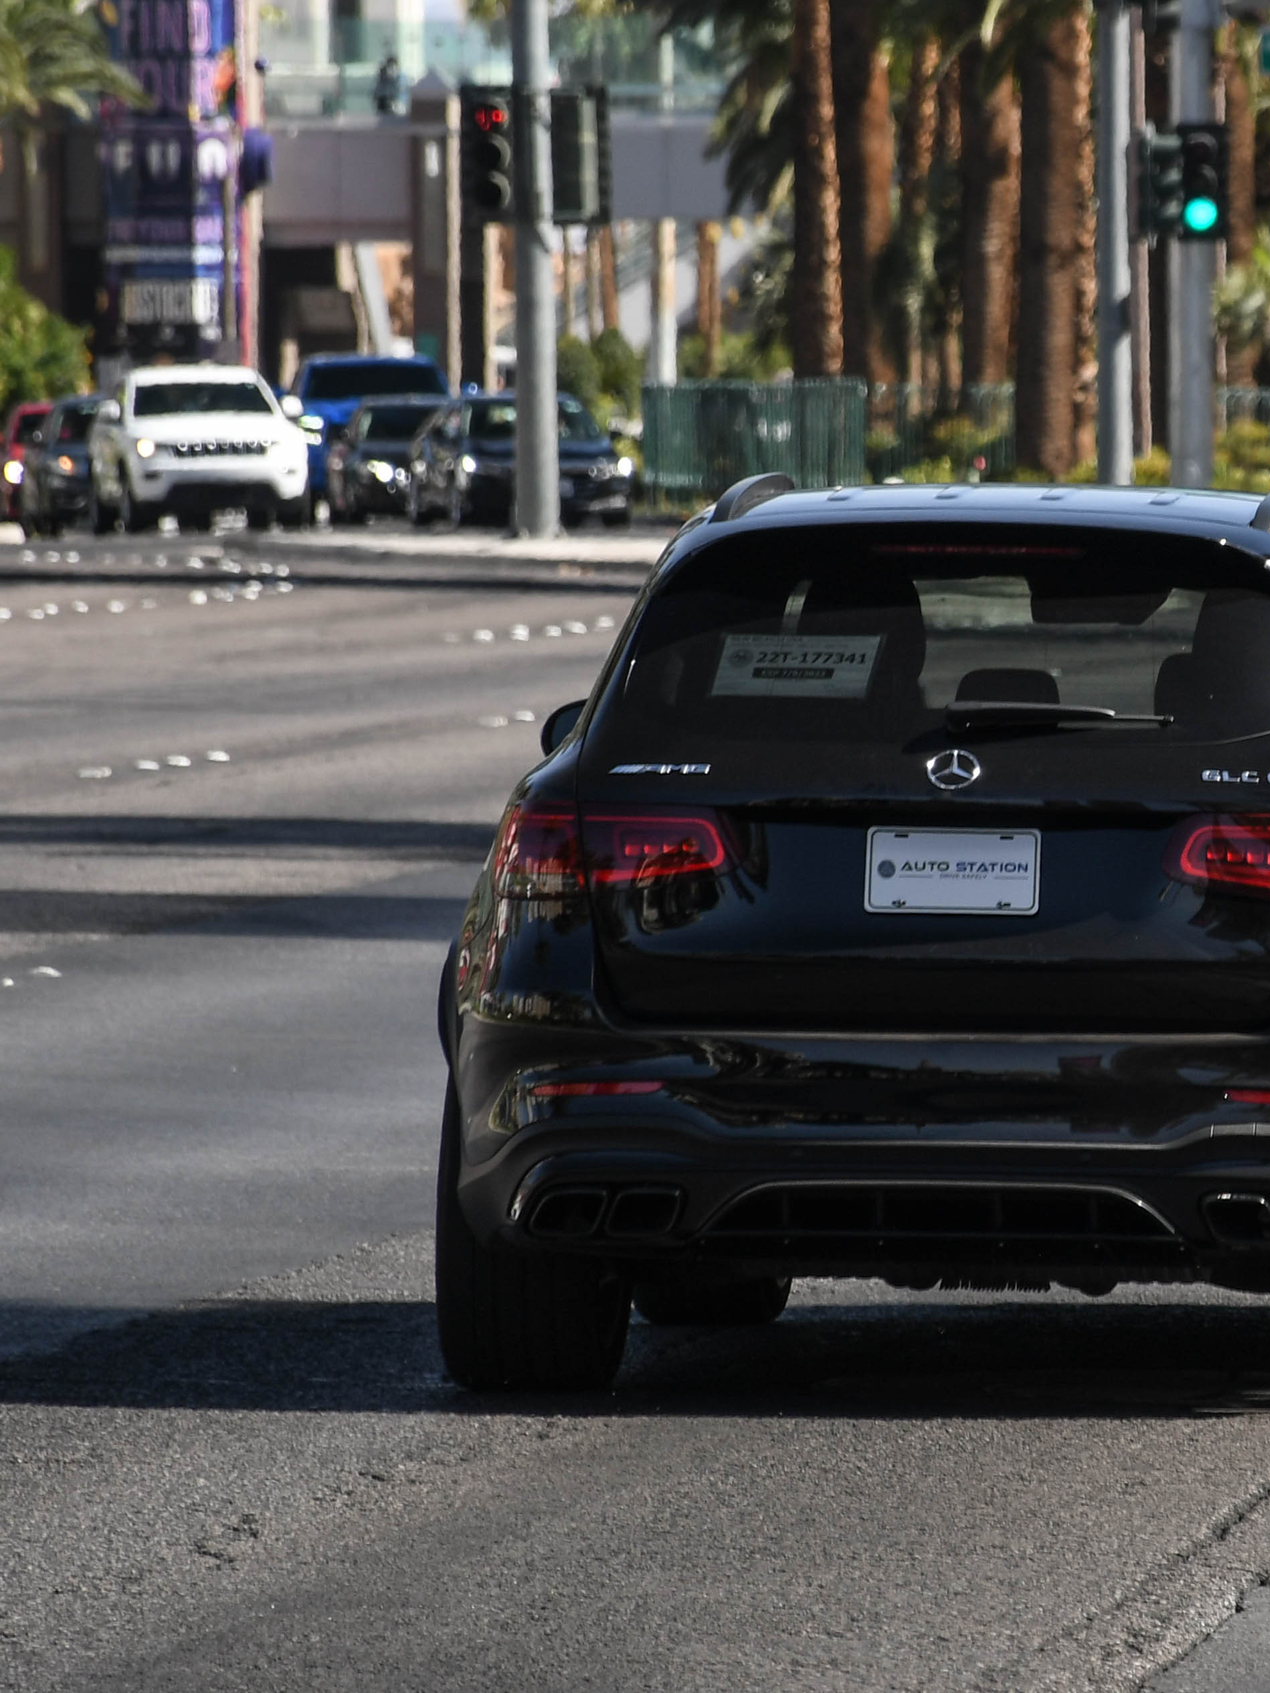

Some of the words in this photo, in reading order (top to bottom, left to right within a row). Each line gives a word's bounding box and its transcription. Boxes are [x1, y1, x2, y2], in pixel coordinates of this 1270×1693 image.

[756, 651, 867, 665] 22T-177341
[636, 763, 711, 775] AMG
[1201, 769, 1260, 783] GLC
[901, 860, 949, 872] AUTO
[956, 861, 1029, 874] STATION
